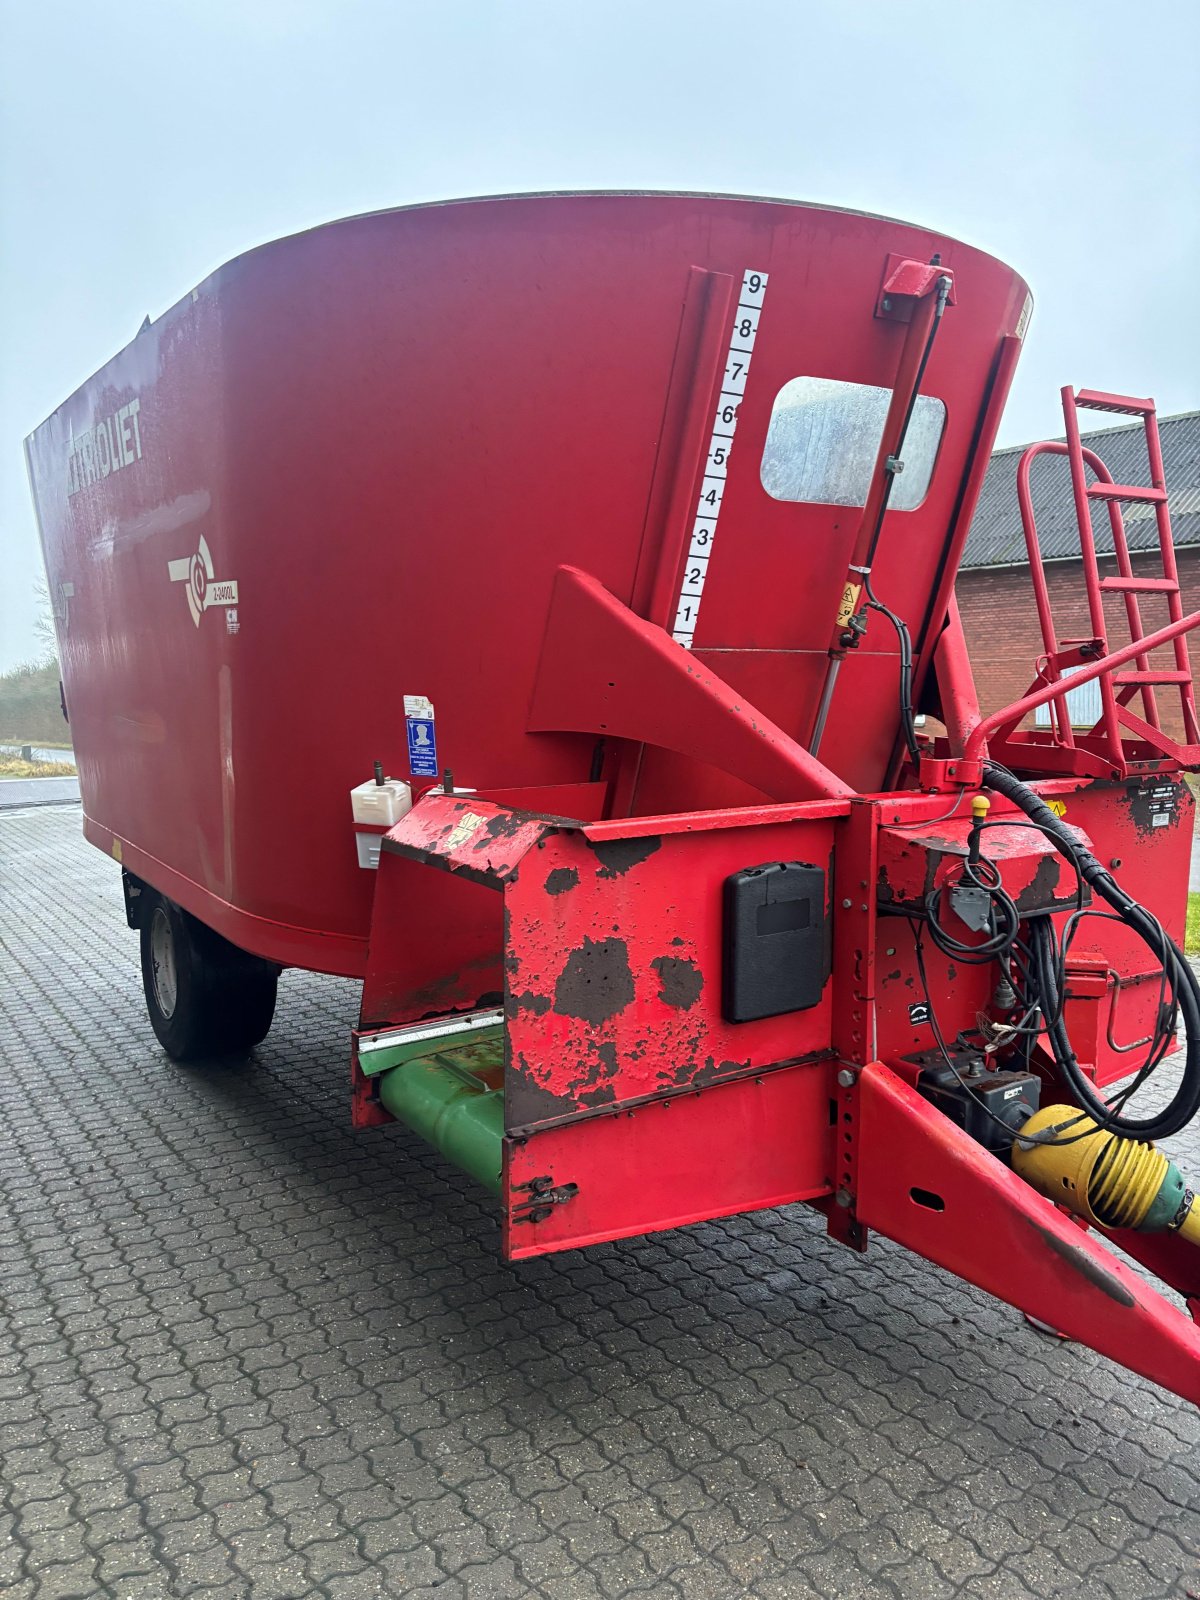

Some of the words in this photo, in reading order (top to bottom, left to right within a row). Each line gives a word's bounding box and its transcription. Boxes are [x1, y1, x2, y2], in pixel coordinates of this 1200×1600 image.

[748, 274, 762, 294] 9
[739, 318, 752, 338] 8
[731, 362, 744, 381] 7
[722, 405, 735, 424] 6
[713, 447, 726, 466] 5
[705, 489, 717, 506] 4
[697, 528, 709, 546] 3
[688, 567, 701, 585] 2
[683, 605, 692, 622] 1
